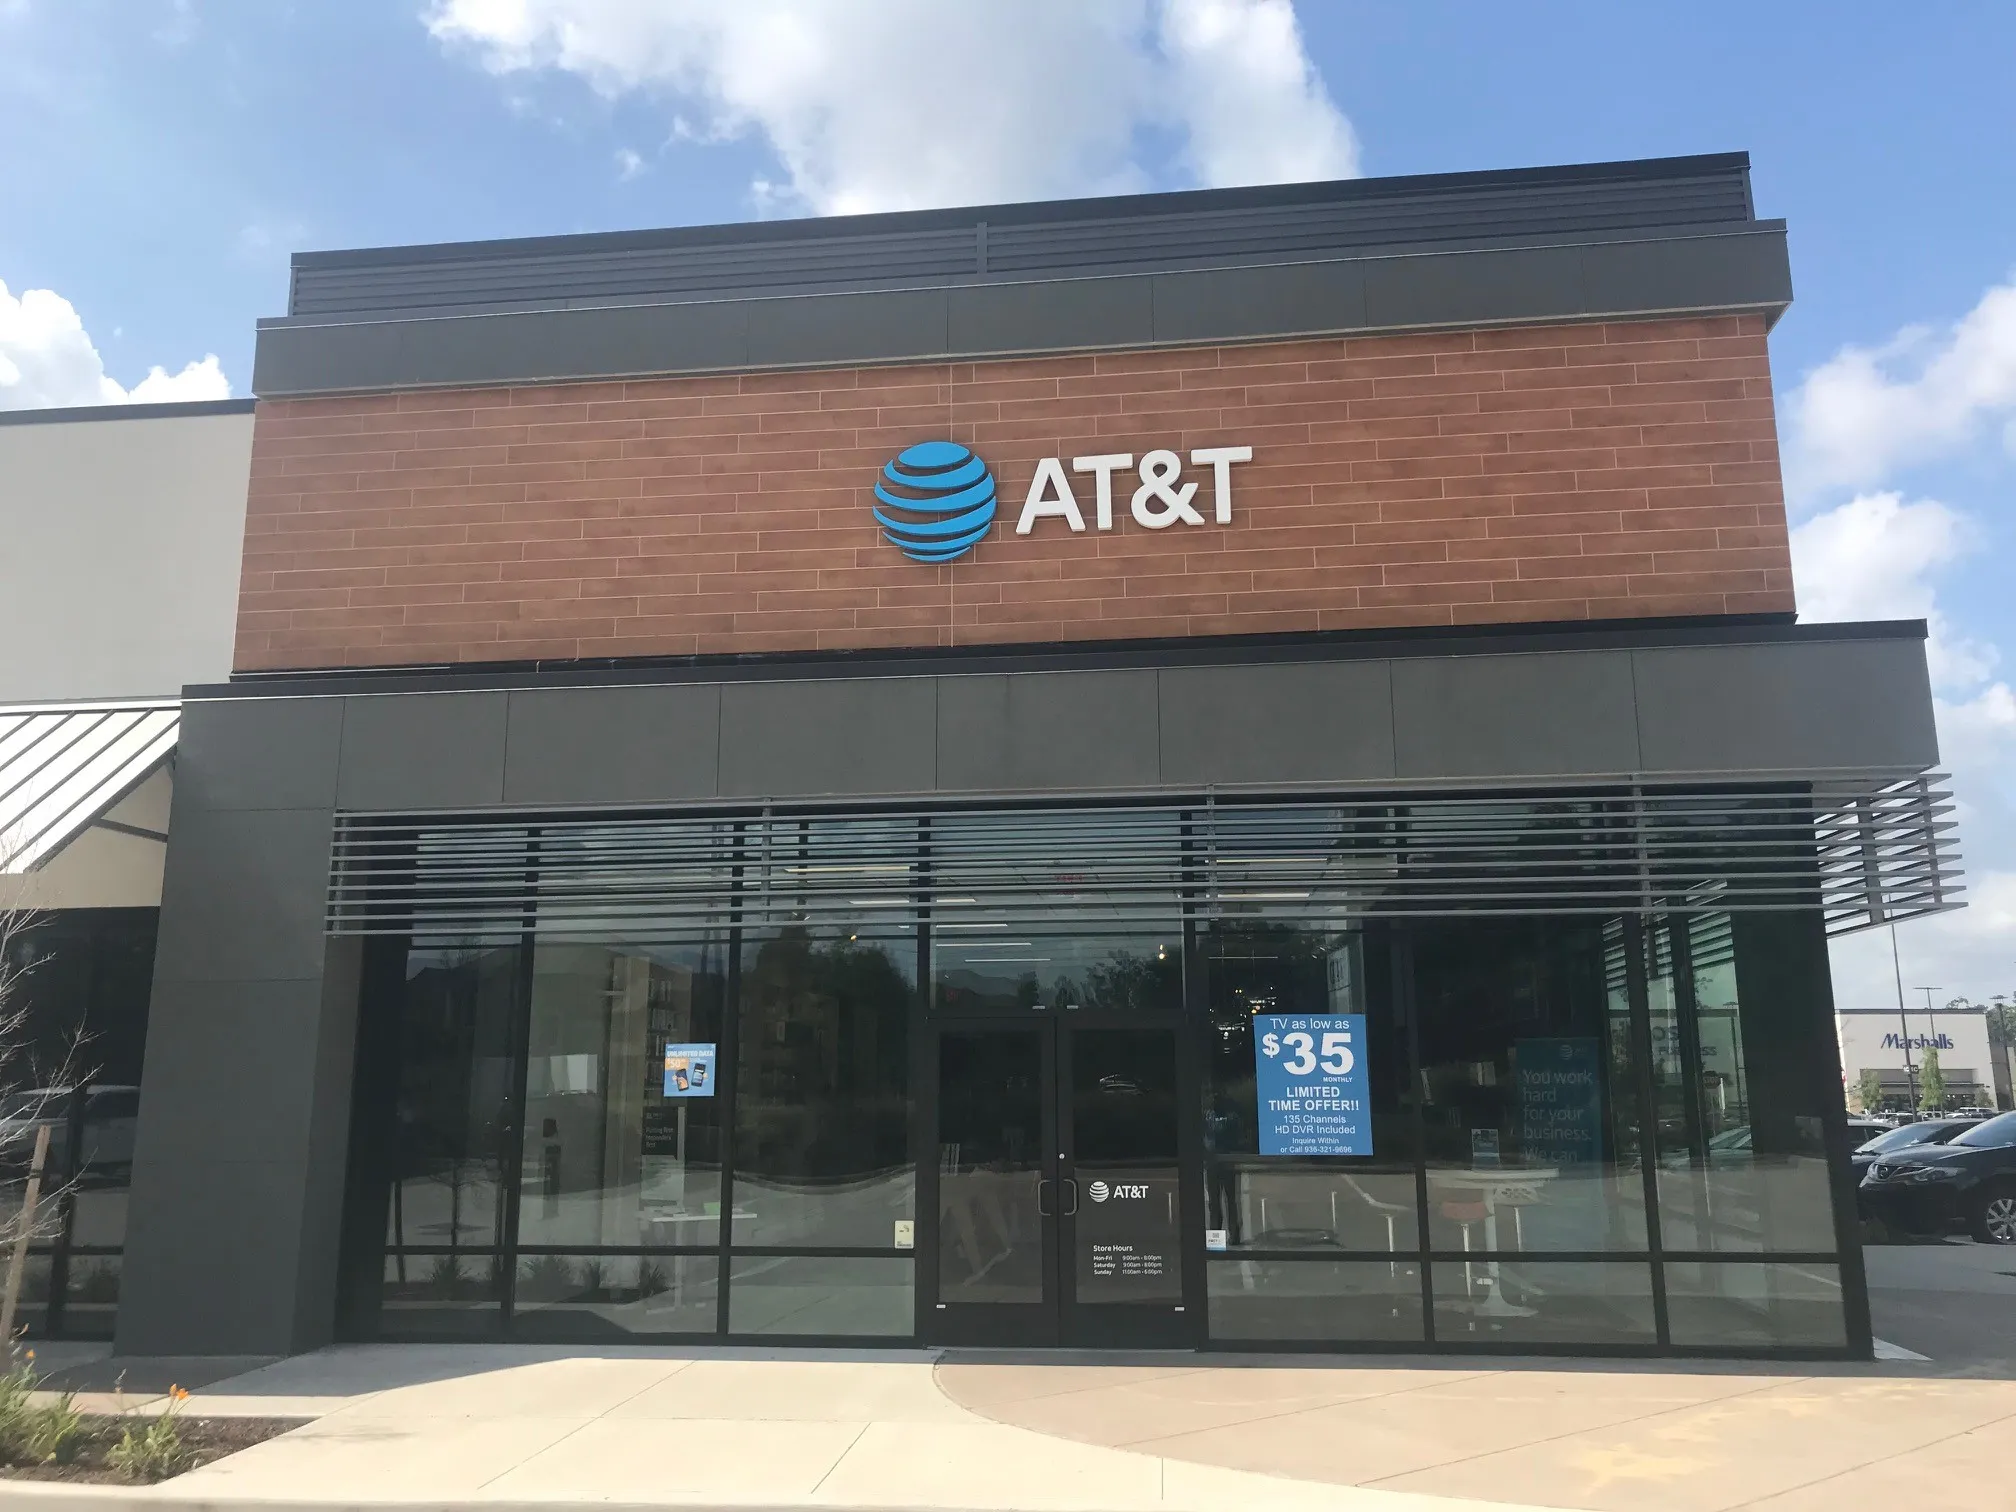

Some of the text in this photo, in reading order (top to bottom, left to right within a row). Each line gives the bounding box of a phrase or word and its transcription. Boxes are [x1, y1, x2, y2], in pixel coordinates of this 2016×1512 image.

[1015, 446, 1253, 535] AT&T
[1270, 1018, 1350, 1029] TV as low as
[1881, 1033, 1954, 1050] Marshalls
[1522, 1069, 1593, 1084] You work
[1286, 1086, 1340, 1098] LIMITED
[1522, 1087, 1557, 1102] hard
[1268, 1100, 1359, 1111] TIME OFFER!!
[1283, 1114, 1346, 1124] 135 Channels
[1522, 1105, 1584, 1126] for your
[1275, 1125, 1356, 1134] HD DVR Included
[1523, 1123, 1592, 1140] business.
[1113, 1185, 1149, 1199] AT&T
